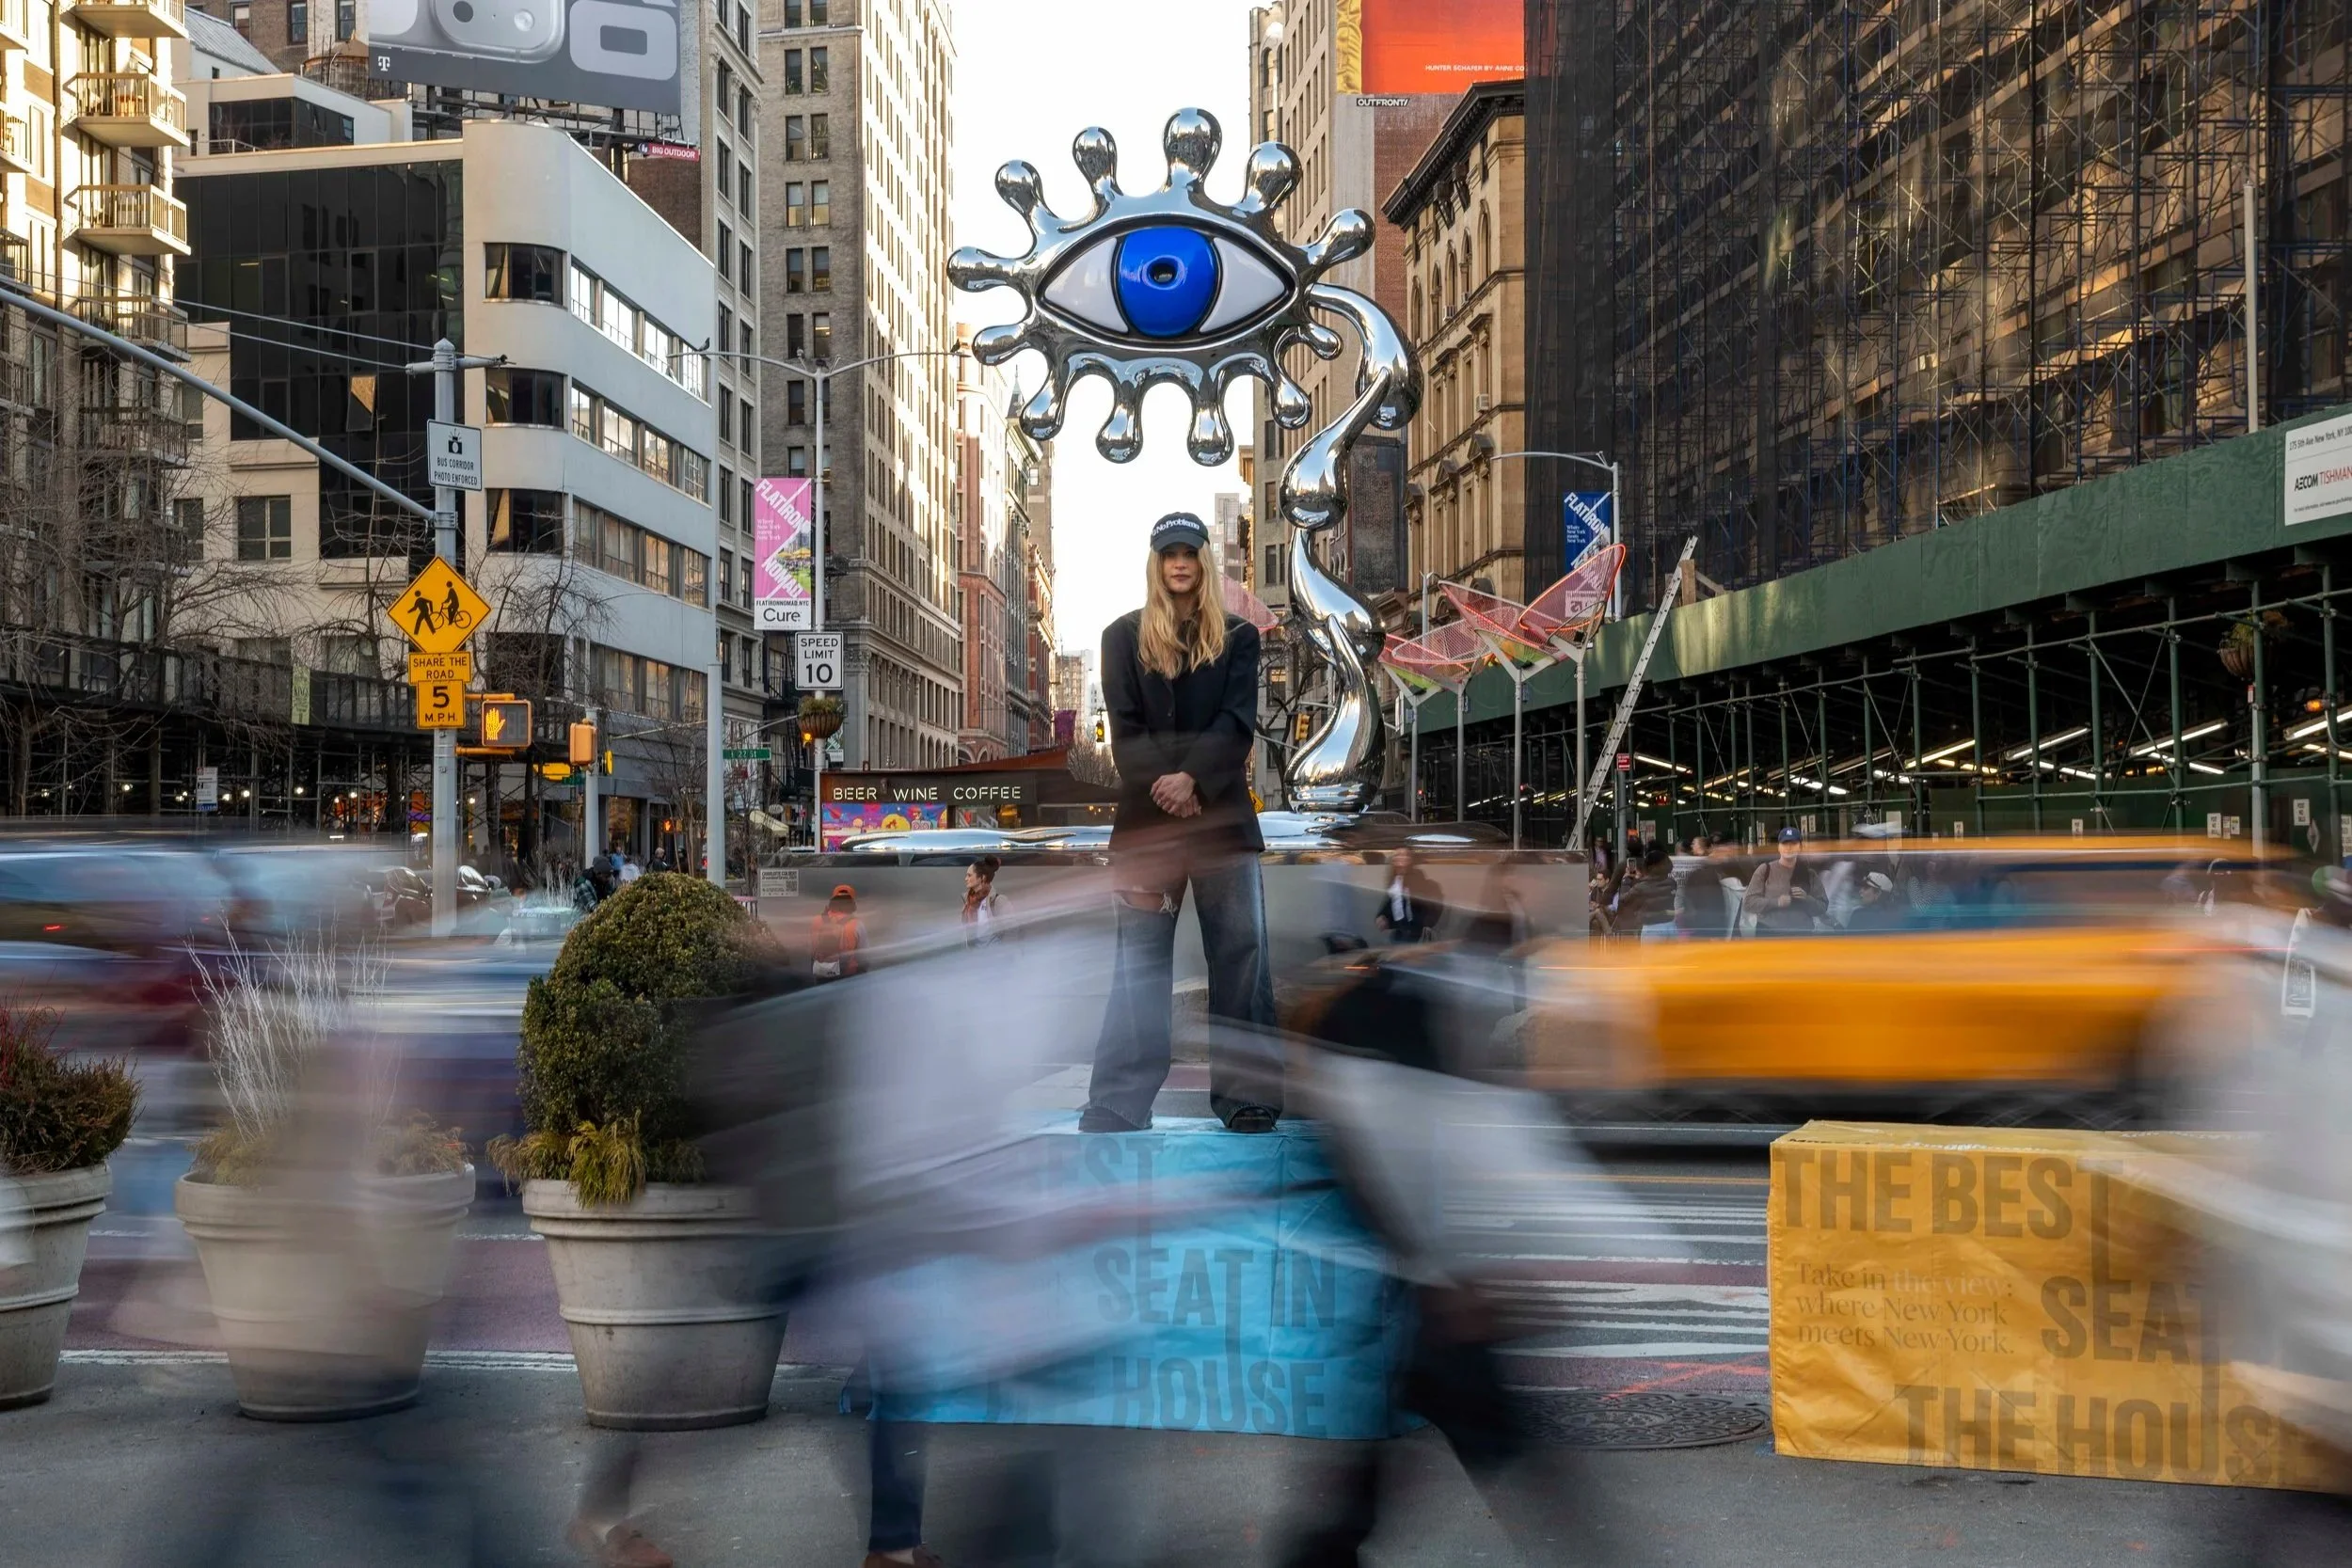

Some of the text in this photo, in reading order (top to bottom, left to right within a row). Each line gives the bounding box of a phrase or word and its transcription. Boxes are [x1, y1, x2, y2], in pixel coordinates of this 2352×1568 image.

[651, 146, 696, 159] BIG OUTDOOR
[2314, 435, 2325, 443] New
[2337, 428, 2344, 437] NY
[437, 457, 474, 471] BUS CORRIDOR
[434, 471, 478, 486] PHOTO ENFORCED
[2294, 472, 2319, 491] AECOM
[755, 478, 811, 534] FLATIRON
[1564, 492, 1610, 535] FLATIRON
[761, 556, 804, 600] NOMAD
[801, 638, 839, 647] SPEED
[413, 657, 468, 668] SHARE THE
[804, 650, 834, 659] LIMIT
[426, 669, 454, 679] ROAD
[806, 663, 834, 684] 10
[433, 686, 450, 708] 5
[833, 785, 1022, 801] BEER WINE COFFEE
[1772, 1148, 2123, 1265] THE BEST
[1795, 1262, 1855, 1289] Take
[1862, 1267, 1886, 1291] in
[1892, 1268, 1937, 1294] the
[1093, 1246, 1253, 1343] SEAT
[1272, 1248, 1336, 1329] IN
[1795, 1291, 2009, 1325] where New York
[1798, 1323, 2015, 1355] meets New York.
[2040, 1275, 2223, 1387] SEAT
[1109, 1356, 1327, 1438] HOUSE
[1894, 1384, 2035, 1469] THE
